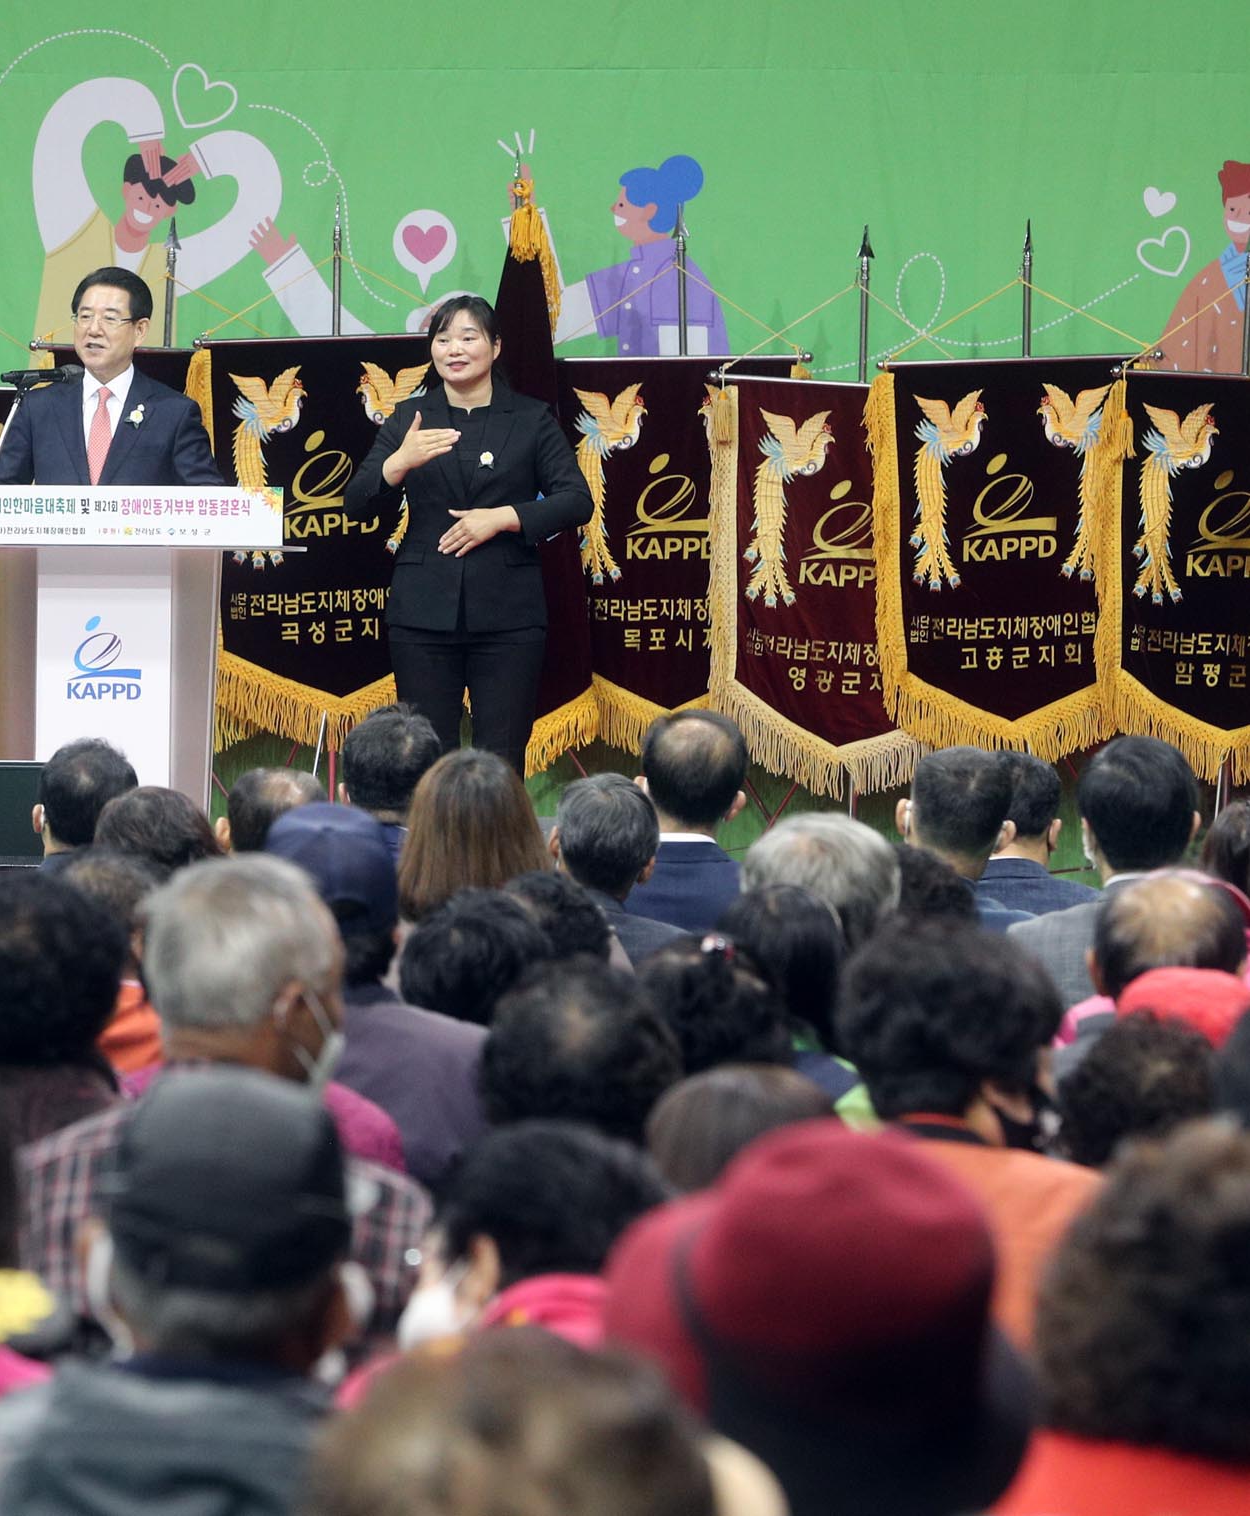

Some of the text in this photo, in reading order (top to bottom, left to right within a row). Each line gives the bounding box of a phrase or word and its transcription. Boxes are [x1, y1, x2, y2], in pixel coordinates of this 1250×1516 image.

[80, 498, 91, 515] 및
[94, 500, 118, 513] 제21회
[120, 498, 194, 516] 장애인동거부부
[198, 498, 251, 516] 합동결혼식
[963, 535, 1057, 562] KAPPD
[250, 586, 391, 617] 전라남도지체장애
[911, 615, 930, 629] 사단
[910, 630, 929, 643] 법인
[961, 642, 1082, 670] 고흥군지회
[66, 682, 142, 701] KAPPD
